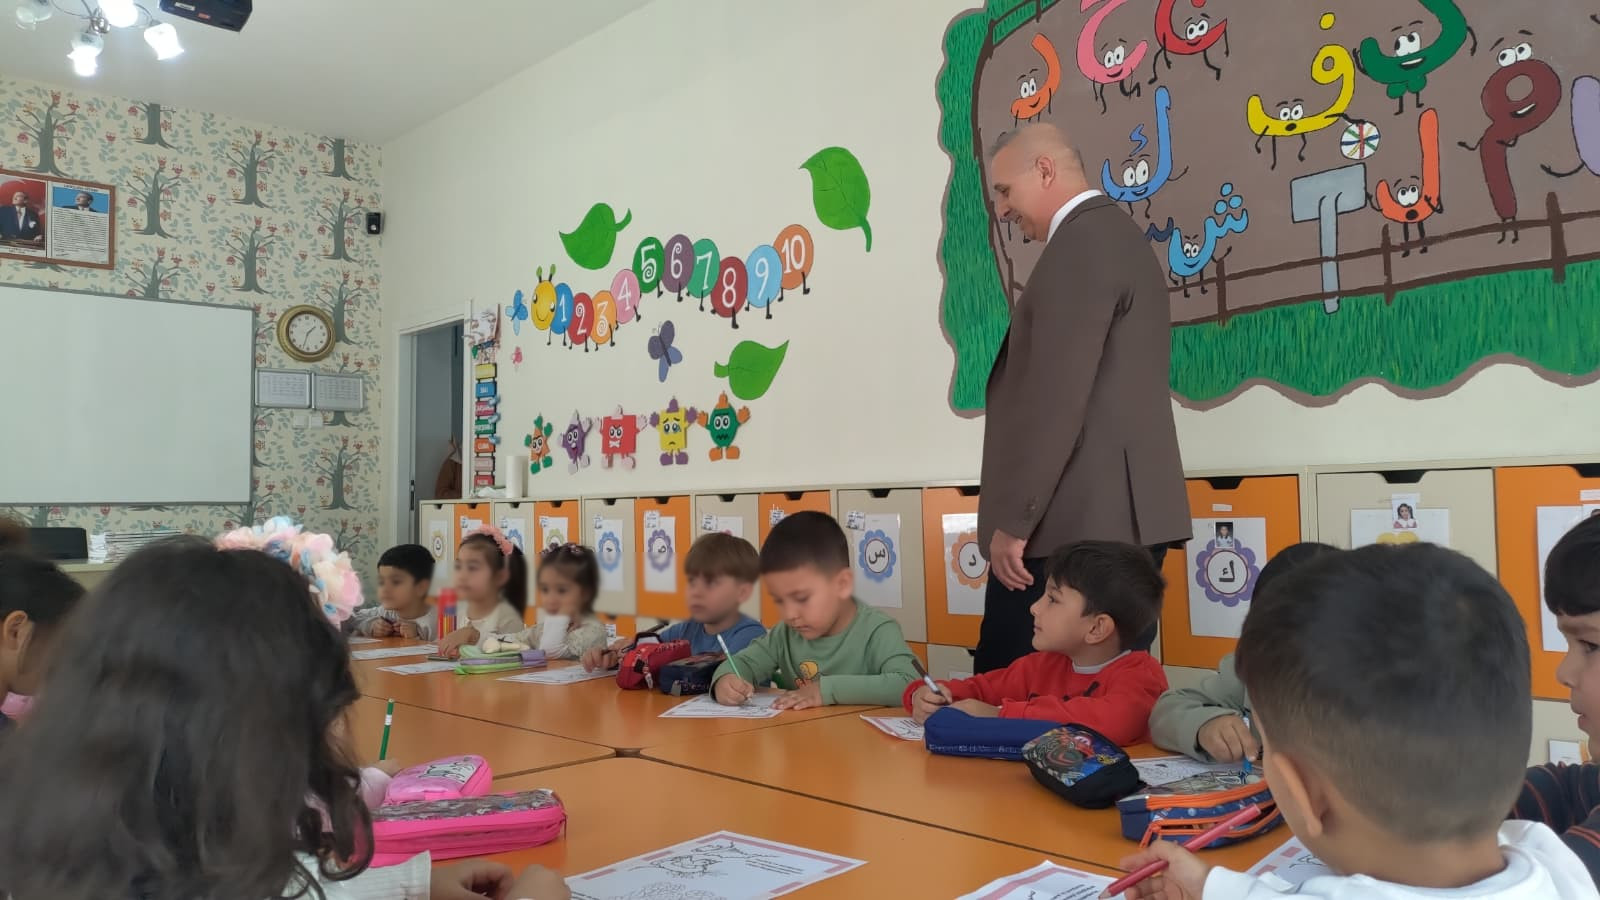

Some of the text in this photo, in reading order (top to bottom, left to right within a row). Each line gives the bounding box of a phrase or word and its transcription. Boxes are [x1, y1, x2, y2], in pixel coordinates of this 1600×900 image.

[1247, 12, 1355, 137] ف
[1168, 183, 1249, 277] ش
[559, 234, 806, 336] 1 2 3 4 5 6 7 8 9 10
[868, 548, 886, 564] س
[968, 554, 977, 566] د
[1219, 560, 1235, 582] ك
